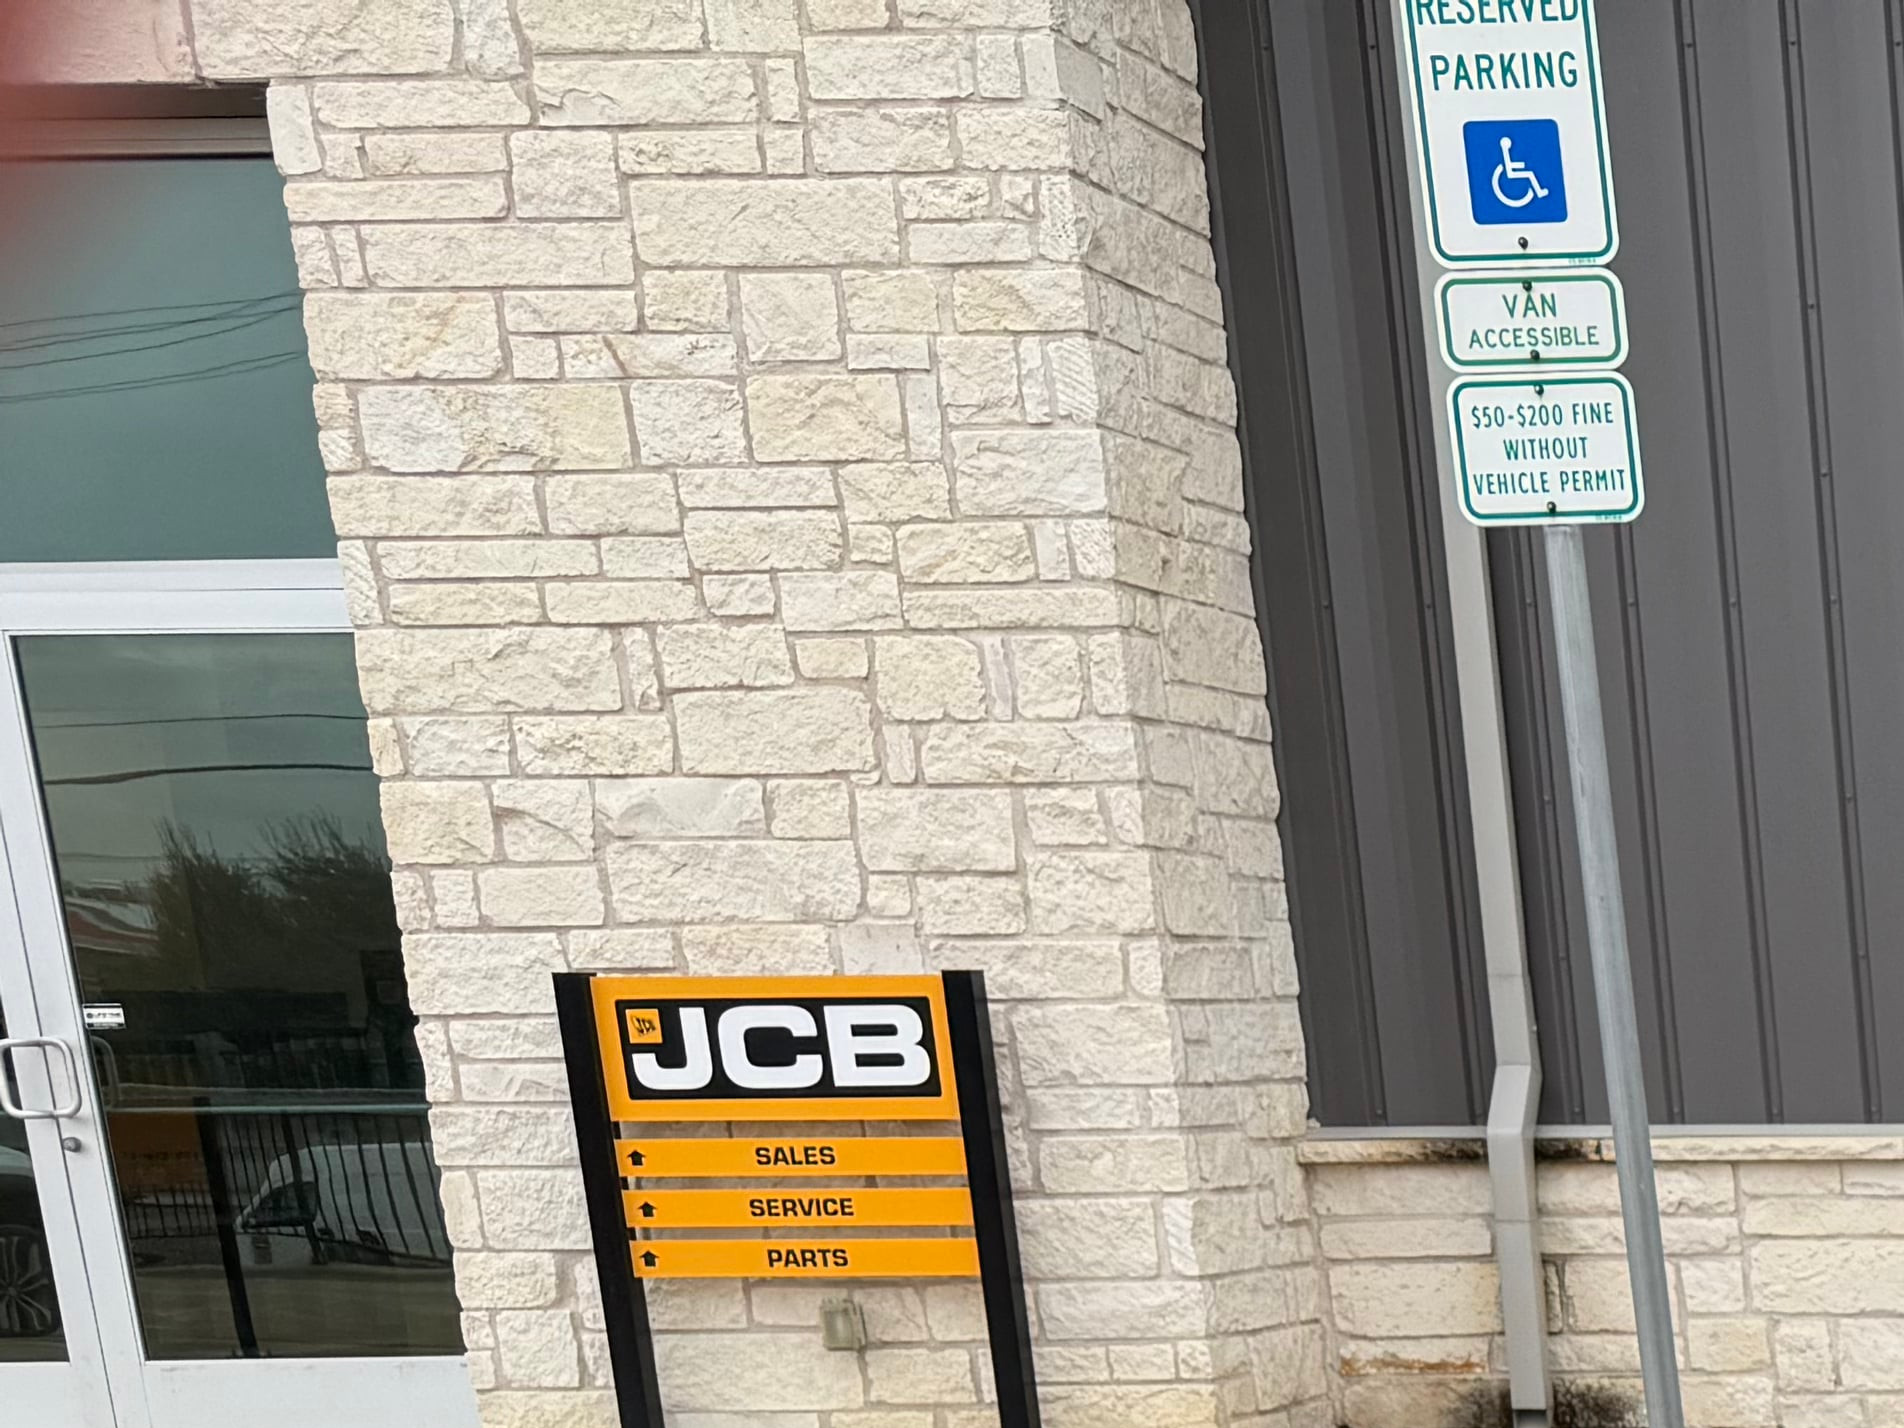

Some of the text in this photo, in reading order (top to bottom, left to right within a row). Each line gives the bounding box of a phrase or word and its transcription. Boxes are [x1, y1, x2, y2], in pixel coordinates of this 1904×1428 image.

[1416, 0, 1579, 25] RESERVED
[1429, 51, 1578, 91] PARKING
[1502, 293, 1557, 318] VAN
[1469, 326, 1600, 349] ACCESSIBLE
[1471, 402, 1614, 429] $50-$200 FINE
[1503, 437, 1588, 460] WITHOUT
[1473, 469, 1625, 495] VEHICLE PERMIT
[631, 1004, 931, 1090] JCB
[755, 1146, 836, 1166] SALES
[749, 1197, 855, 1217] SERVICE
[767, 1248, 849, 1268] PARTS
